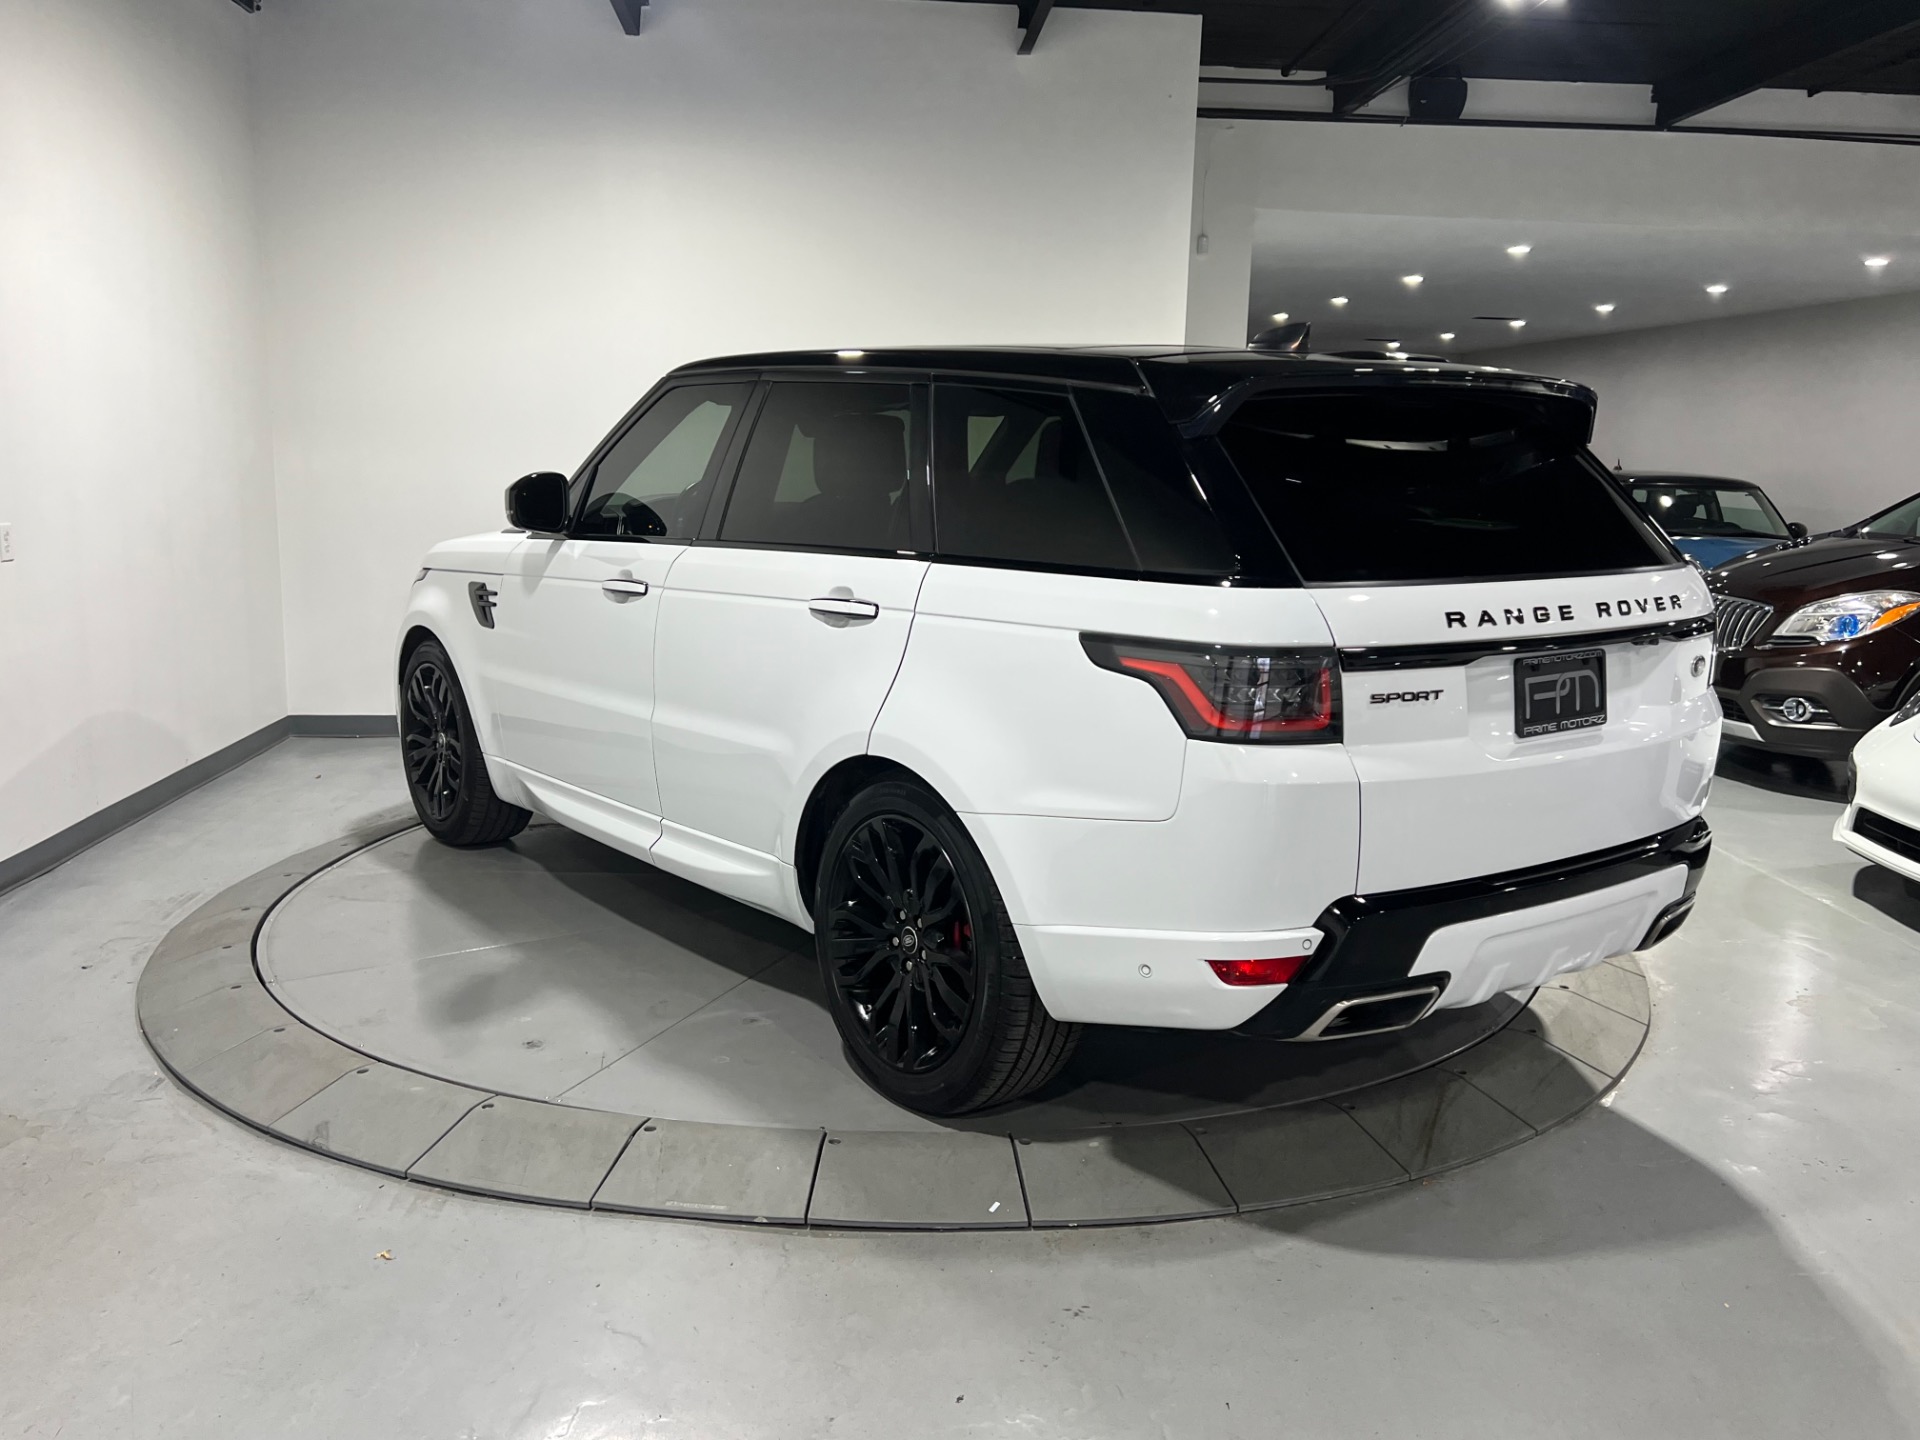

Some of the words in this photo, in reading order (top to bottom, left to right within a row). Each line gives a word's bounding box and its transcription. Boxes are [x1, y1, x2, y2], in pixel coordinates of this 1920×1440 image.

[1445, 604, 1574, 628] RANGE
[1596, 594, 1682, 618] ROVER
[1370, 689, 1444, 704] SPORT
[1523, 722, 1558, 736] PRIME
[1560, 714, 1606, 730] MOTORZ
